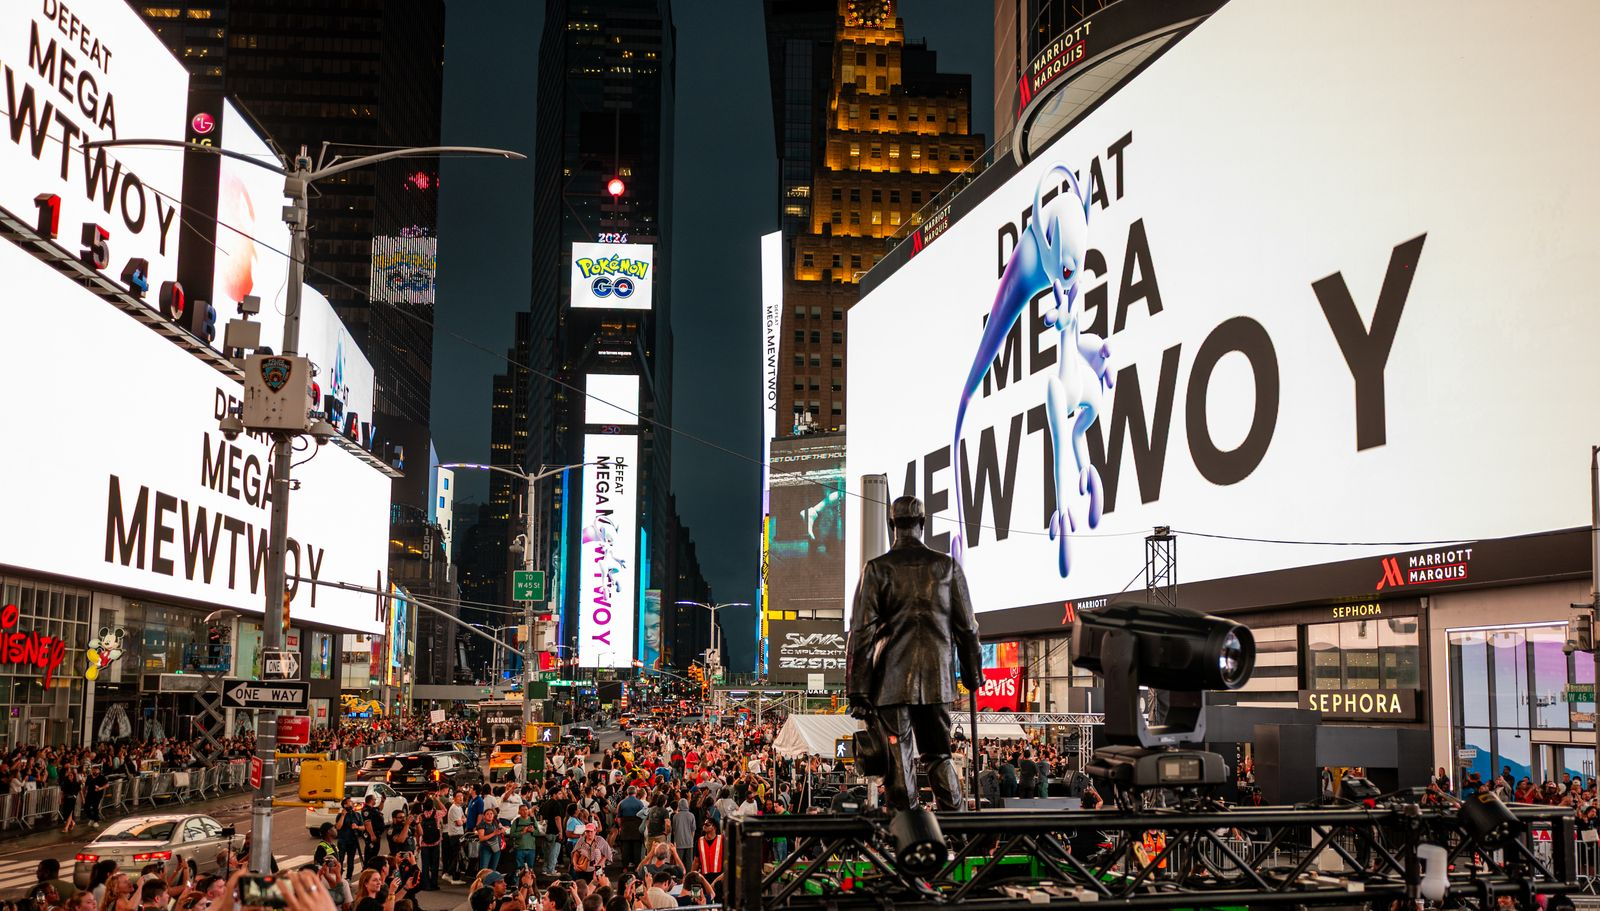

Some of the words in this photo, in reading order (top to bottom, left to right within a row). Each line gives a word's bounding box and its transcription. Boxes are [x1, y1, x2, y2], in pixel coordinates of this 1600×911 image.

[43, 0, 112, 75] DEFEAT
[1033, 21, 1092, 74] MARRIOTT
[28, 18, 117, 140] MEGA
[1033, 43, 1084, 92] MARQUIS
[924, 205, 951, 233] MARRIOTT
[924, 221, 949, 245] MARQUIS
[591, 276, 635, 298] GO
[766, 305, 774, 334] MEGA
[1311, 232, 1428, 453] Y
[596, 456, 610, 505] MEGA
[615, 457, 624, 495] DEFEAT
[1409, 548, 1472, 567] MARRIOTT
[1409, 565, 1465, 582] MARQUIS
[1077, 599, 1107, 610] MARRIOTT
[1332, 604, 1382, 618] SEPHORA
[269, 661, 281, 672] ONE
[235, 688, 260, 700] ONE
[271, 689, 298, 701] WAY
[1309, 693, 1402, 714] SEPHORA
[1568, 692, 1576, 701] W
[1578, 692, 1587, 701] 46
